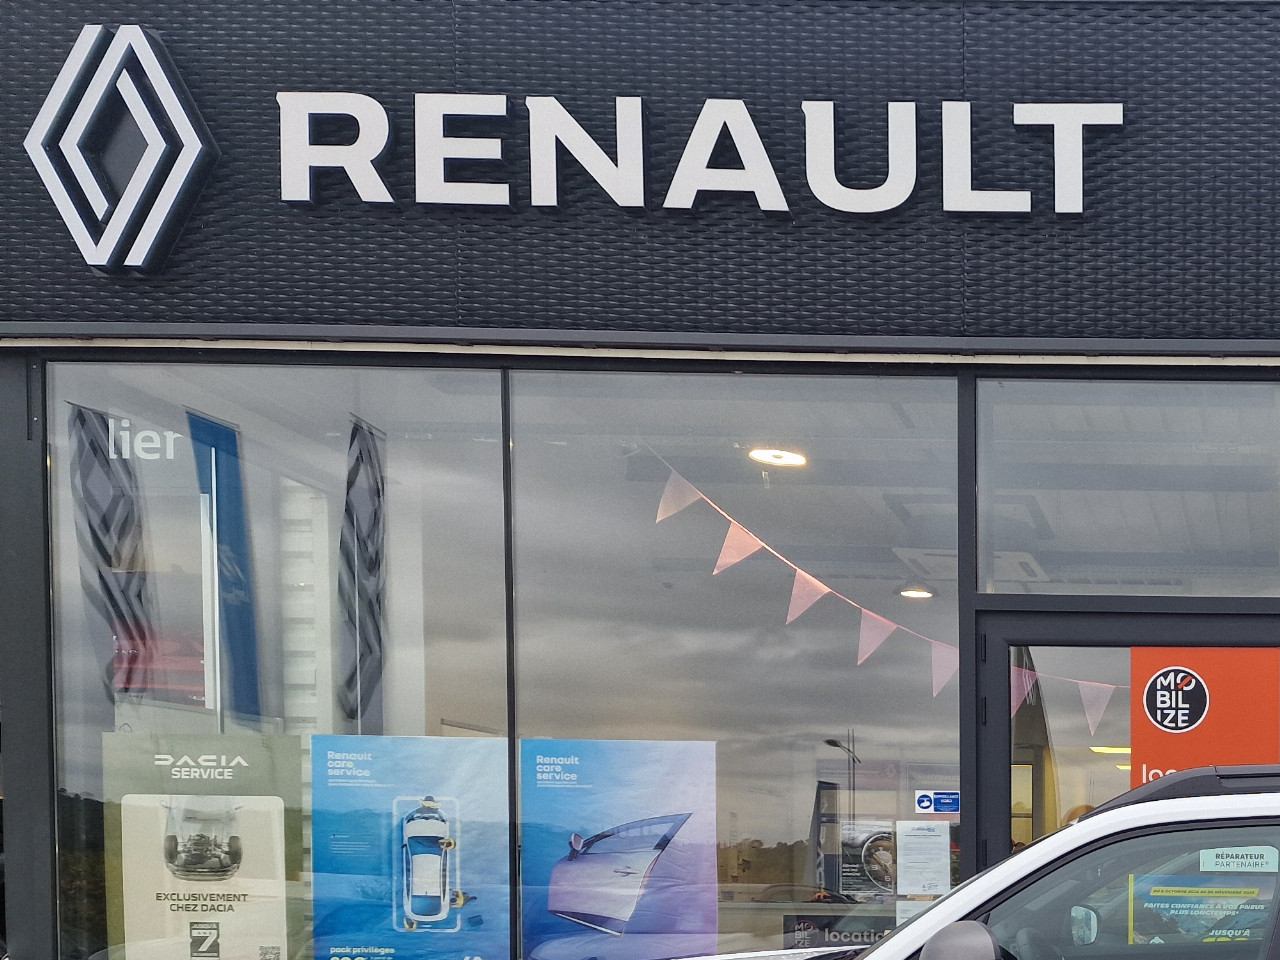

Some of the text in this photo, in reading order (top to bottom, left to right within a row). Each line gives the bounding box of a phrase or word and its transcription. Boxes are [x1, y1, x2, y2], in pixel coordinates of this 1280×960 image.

[276, 91, 1123, 214] RENAULT
[1156, 691, 1190, 708] BIL
[327, 750, 372, 760] Renault
[154, 754, 249, 767] DACIA
[327, 760, 354, 768] care
[536, 755, 580, 765] Renault
[327, 768, 371, 777] service
[536, 764, 562, 772] care
[171, 767, 234, 780] SERVICE
[536, 772, 578, 781] service
[1215, 852, 1264, 860] RÉPARATEUR
[155, 893, 249, 902] EXCLUSIVEMENT
[170, 903, 235, 912] CHEZ DACIA
